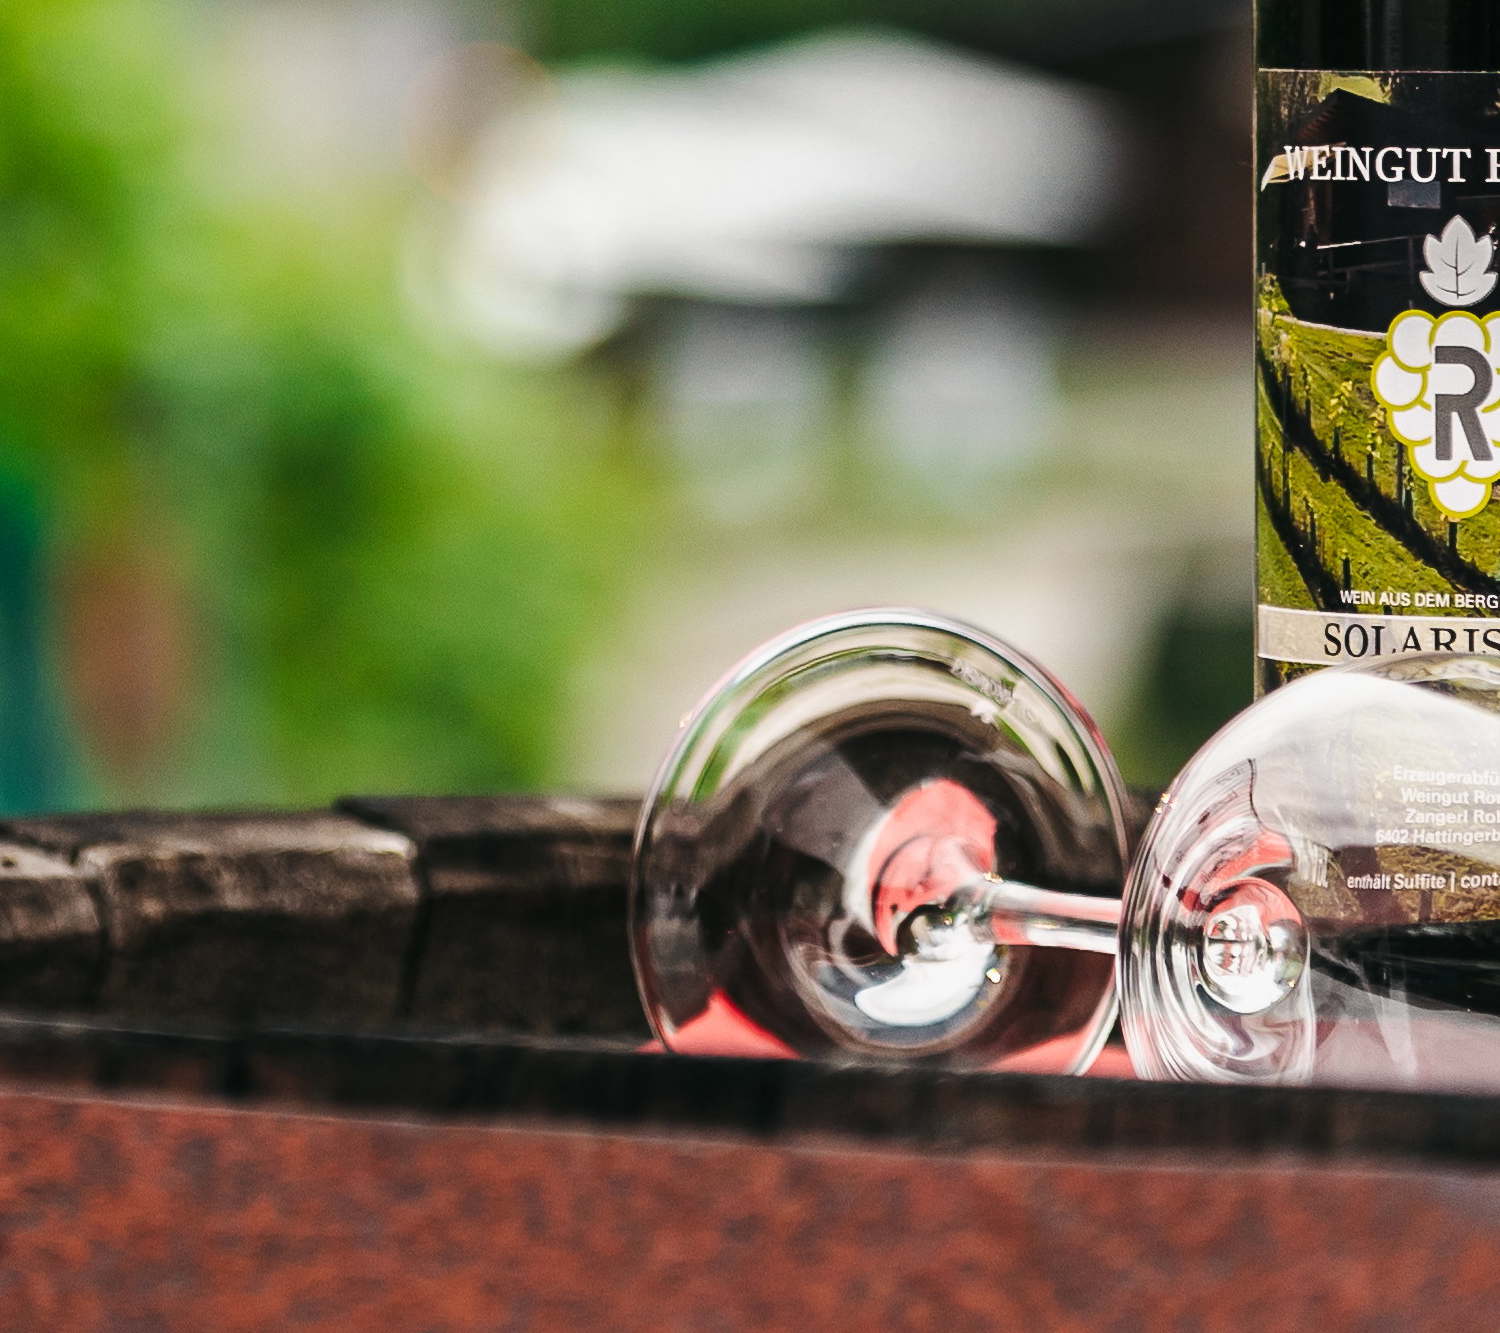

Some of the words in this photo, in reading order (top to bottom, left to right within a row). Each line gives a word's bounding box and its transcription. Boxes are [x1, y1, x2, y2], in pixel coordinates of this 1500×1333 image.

[1284, 144, 1471, 183] WEINGUT
[1434, 345, 1494, 462] R
[1340, 590, 1374, 606] WEIN
[1378, 591, 1411, 607] AUS
[1414, 591, 1450, 608] DEM
[1400, 786, 1470, 807] Weingut
[1405, 807, 1469, 826] Zangerl
[1375, 828, 1409, 844] 6402
[1346, 873, 1391, 890] enthält
[1393, 873, 1447, 890] Sulfite
